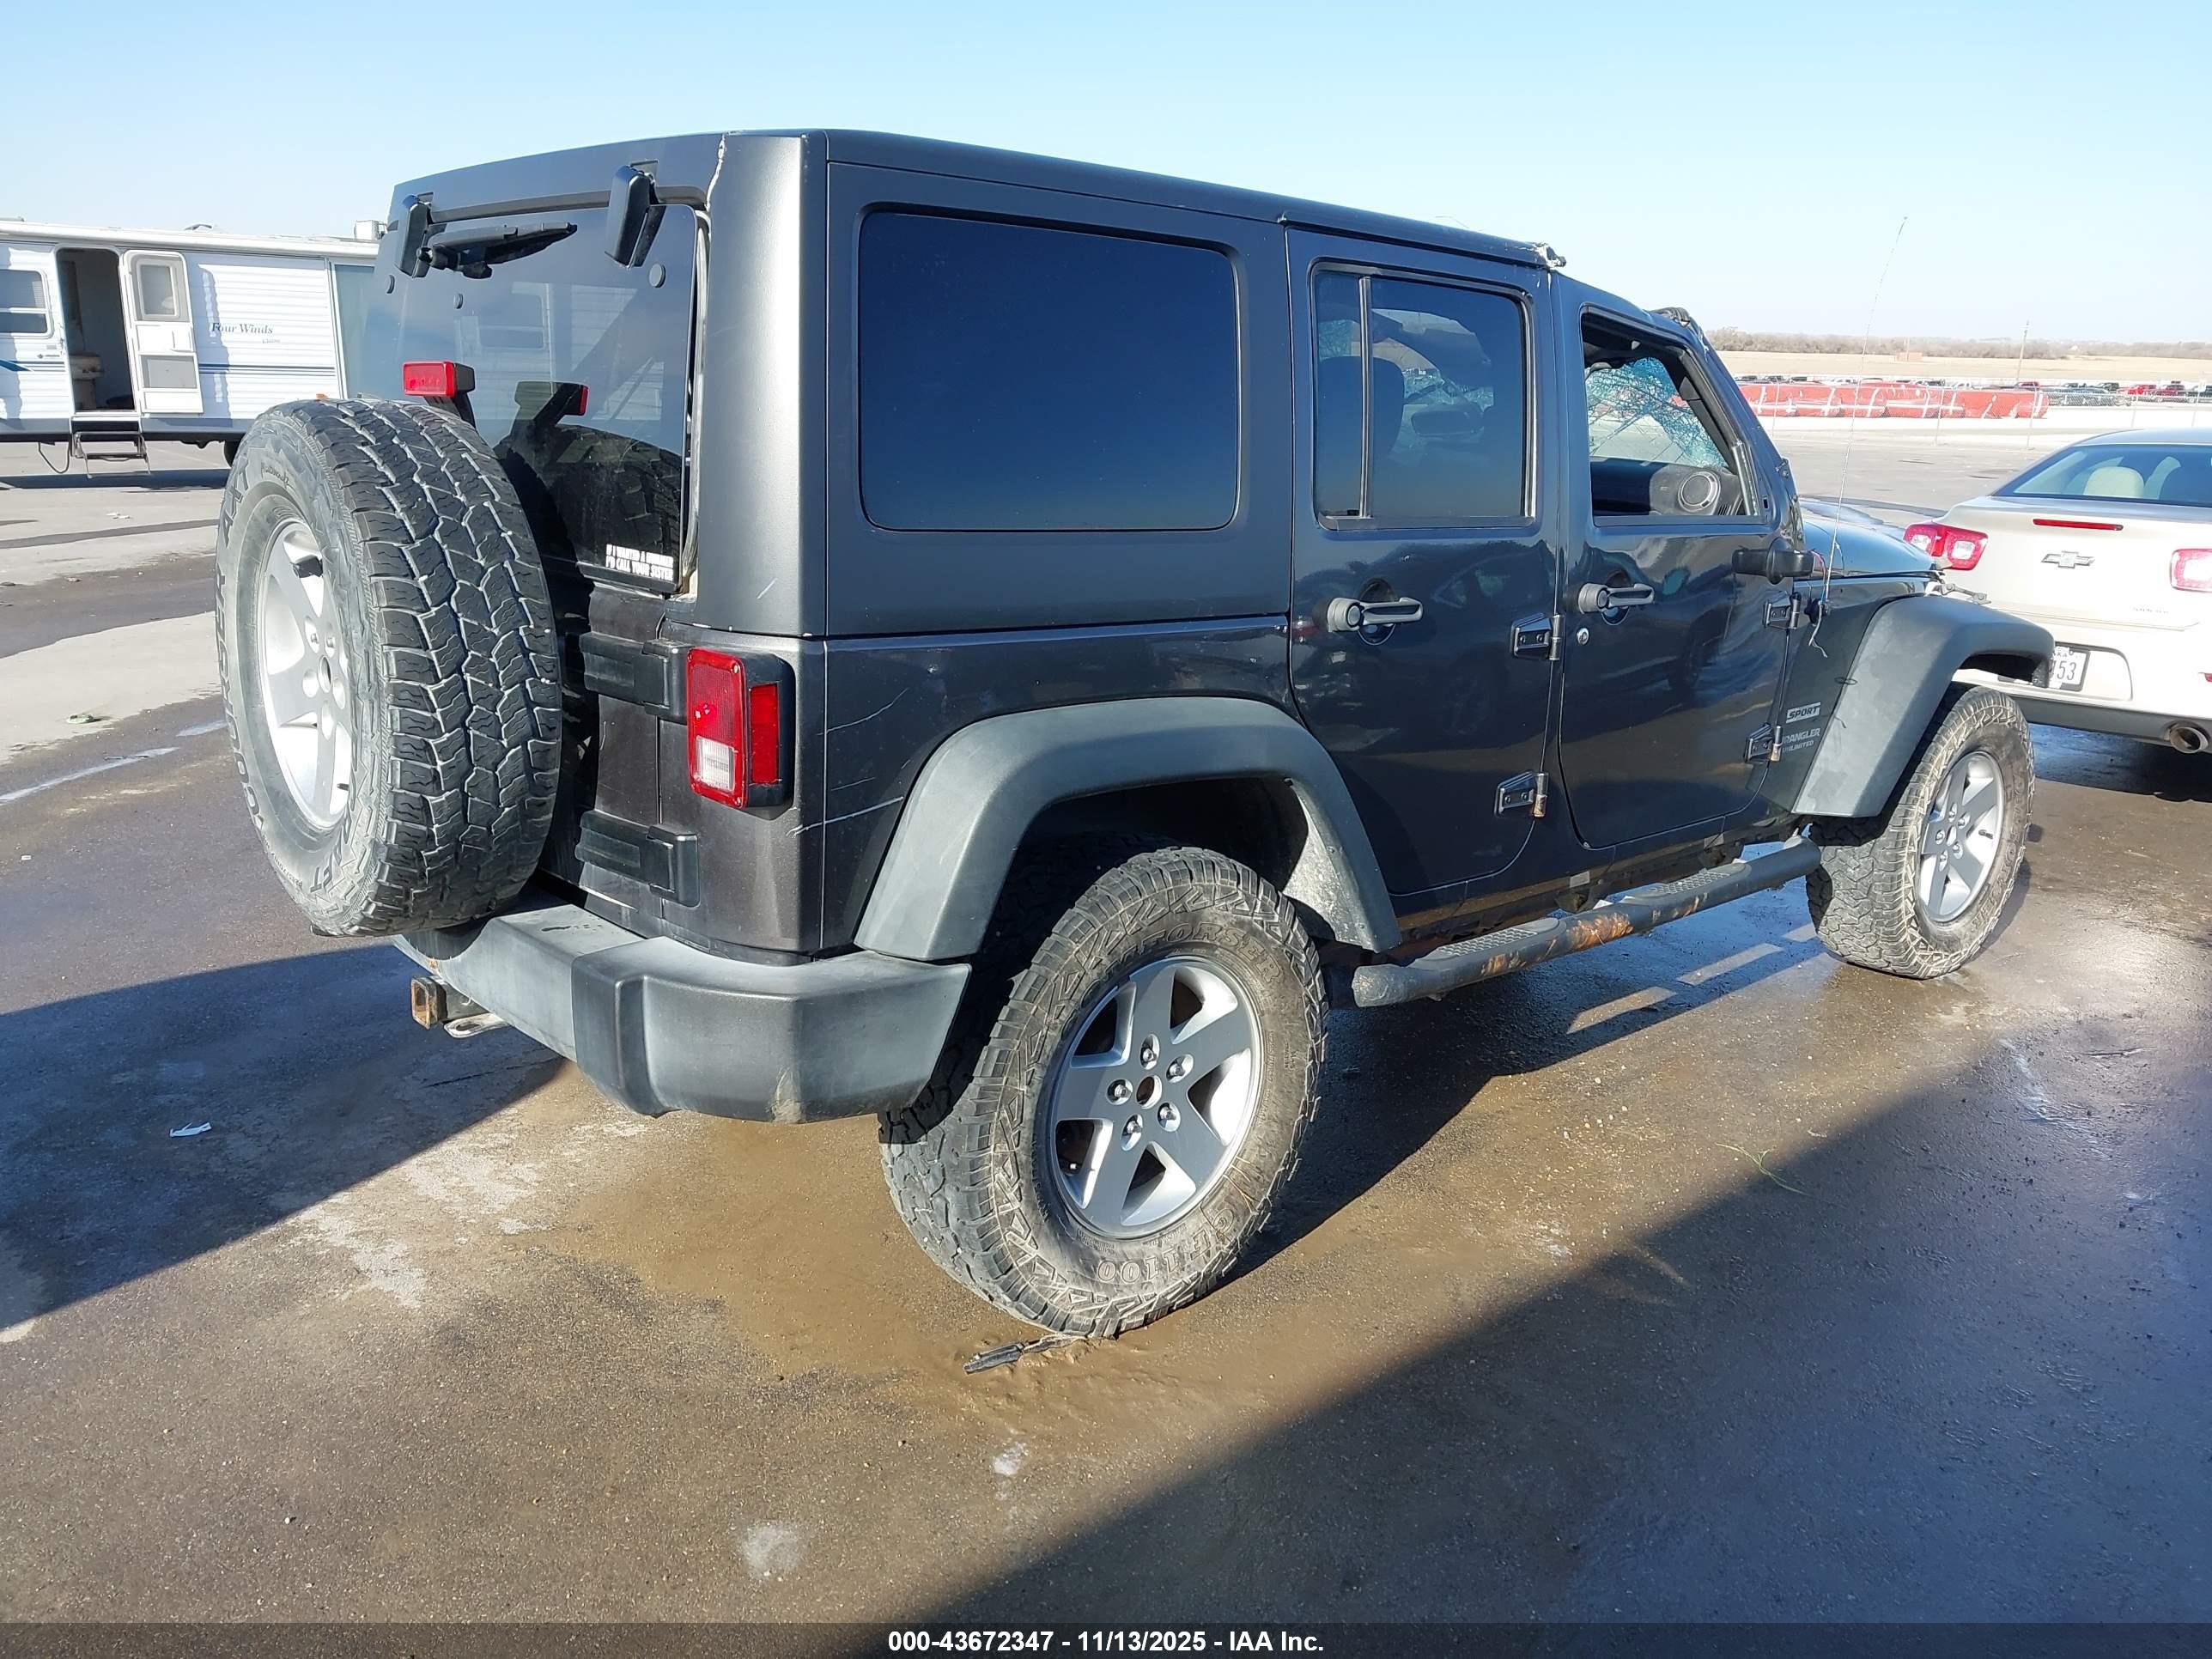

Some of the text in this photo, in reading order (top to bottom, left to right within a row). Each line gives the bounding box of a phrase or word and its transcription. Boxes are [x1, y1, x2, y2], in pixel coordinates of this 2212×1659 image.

[212, 322, 273, 334] Four Winds
[1790, 707, 1817, 720] SPORT
